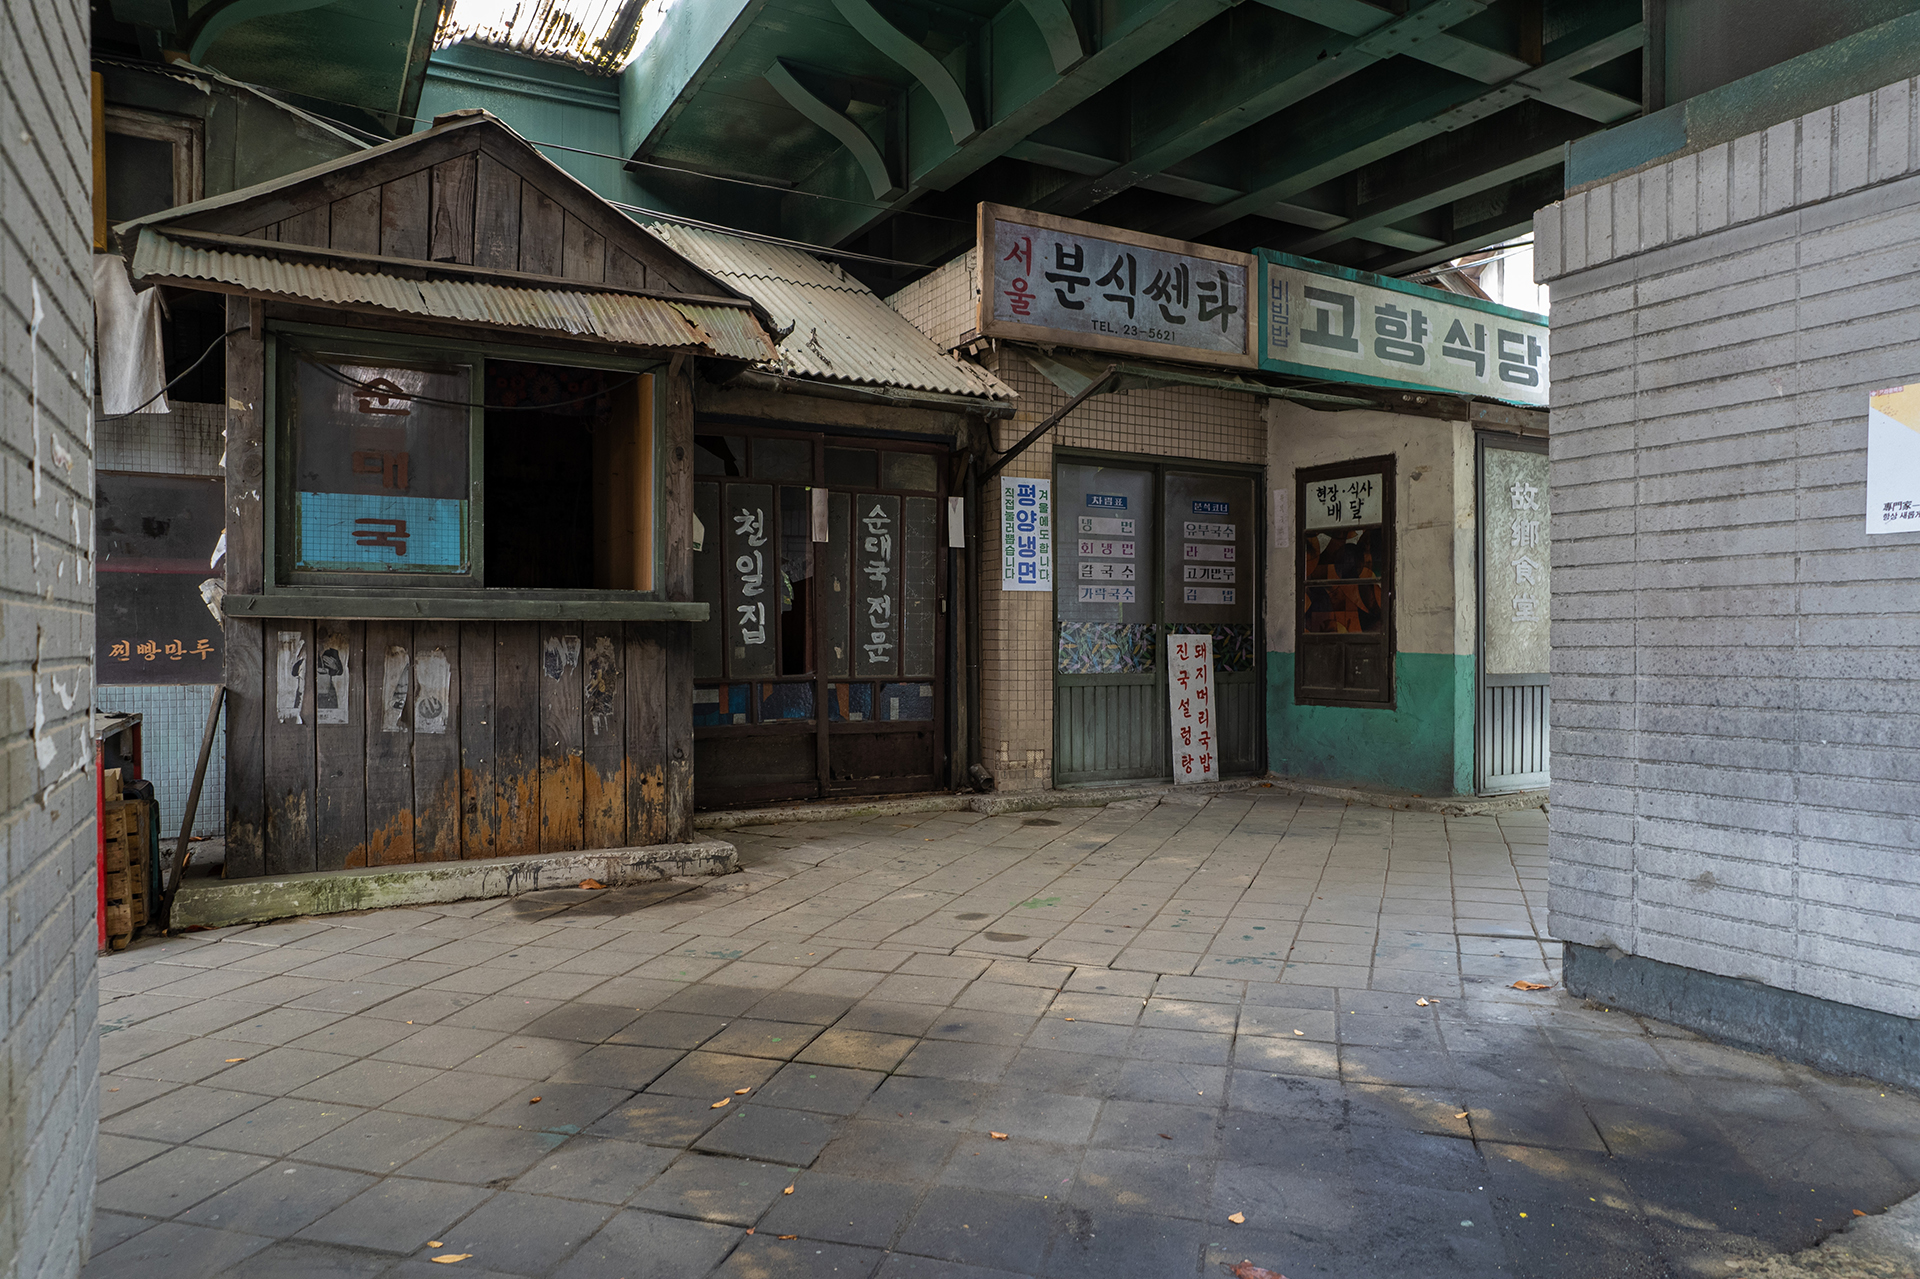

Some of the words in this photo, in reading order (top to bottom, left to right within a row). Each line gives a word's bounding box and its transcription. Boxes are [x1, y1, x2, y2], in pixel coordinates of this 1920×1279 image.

[1003, 236, 1036, 316] 서울
[1044, 242, 1238, 333] 분식쎈타
[1091, 319, 1118, 334] TEL.
[1123, 325, 1176, 341] 23-5621
[1271, 279, 1289, 348] 비빔밥
[1300, 285, 1543, 390] 고향식당
[1016, 484, 1037, 584] 평양냉면
[1186, 523, 1234, 538] 유부국수
[733, 508, 767, 645] 천일집
[1081, 588, 1133, 600] 가락국수
[1186, 567, 1234, 580] 고기만두
[108, 639, 215, 661] 찐빵만두
